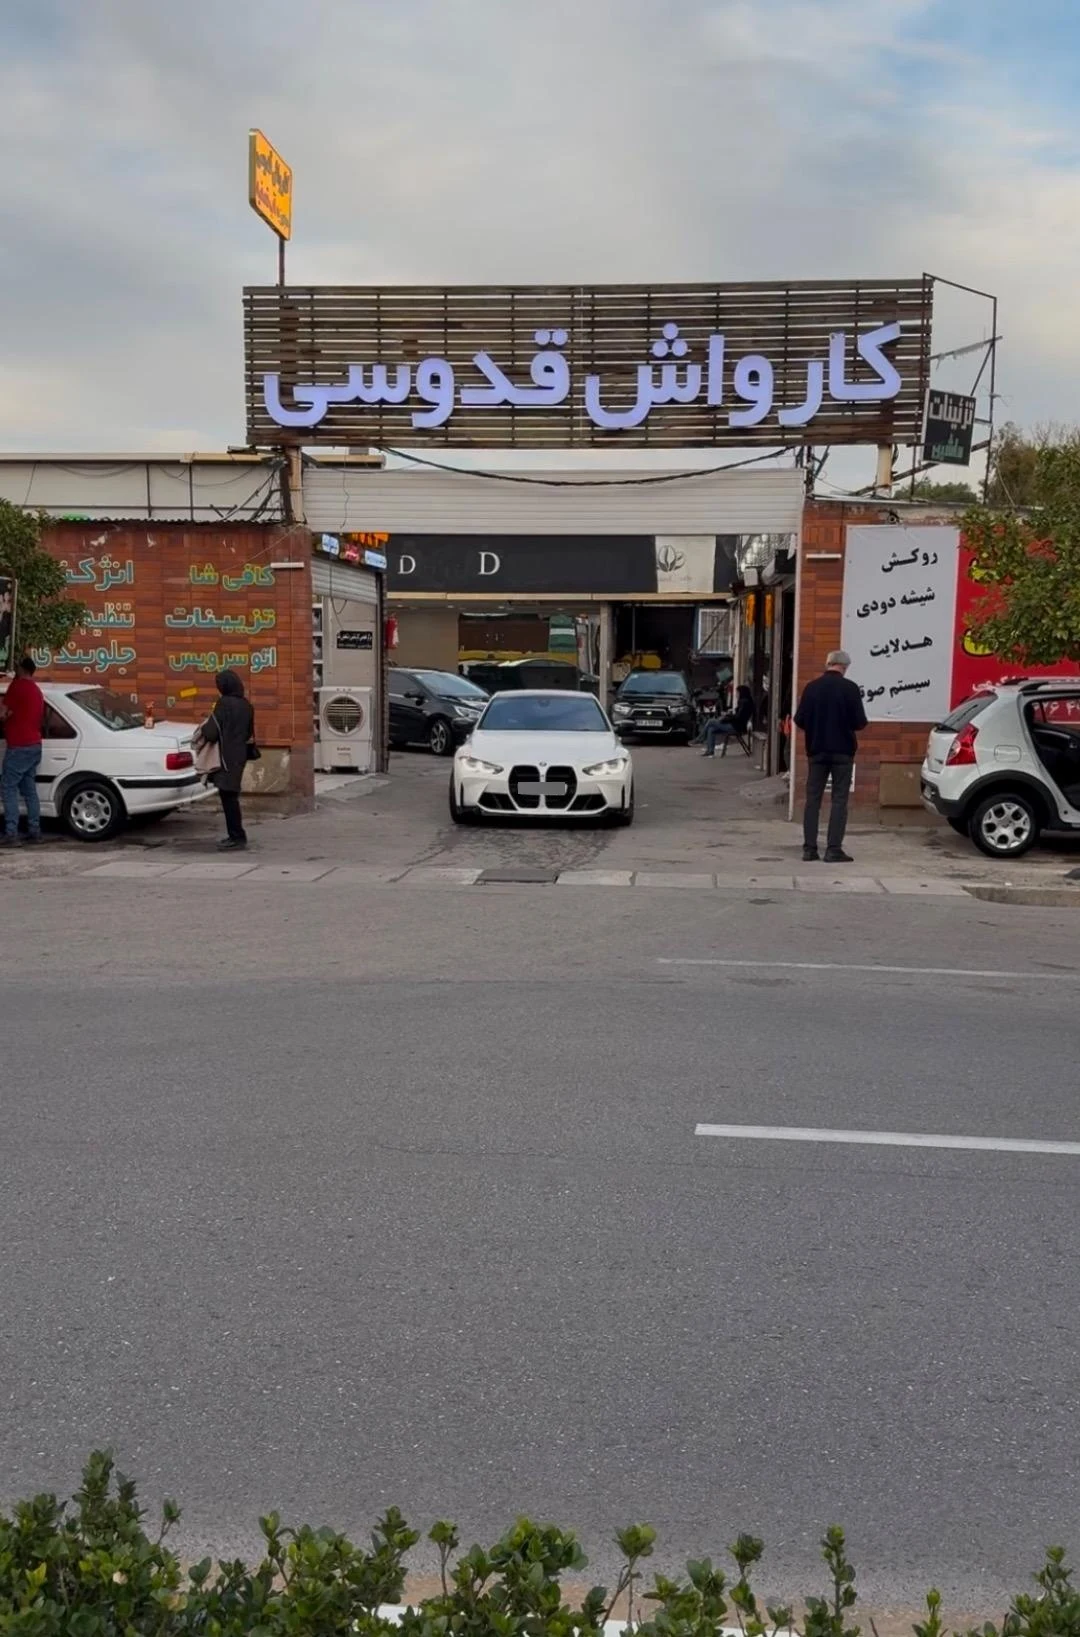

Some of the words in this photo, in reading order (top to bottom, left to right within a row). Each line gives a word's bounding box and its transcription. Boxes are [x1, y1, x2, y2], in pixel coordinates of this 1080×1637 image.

[264, 329, 570, 428] قدوسی
[222, 563, 275, 591] کافی
[856, 597, 896, 618] دودی
[900, 587, 936, 607] شیشه
[31, 639, 136, 674] جلوبندی
[168, 652, 249, 673] سرویس
[250, 647, 277, 673] اتو
[889, 678, 931, 698] سیستم
